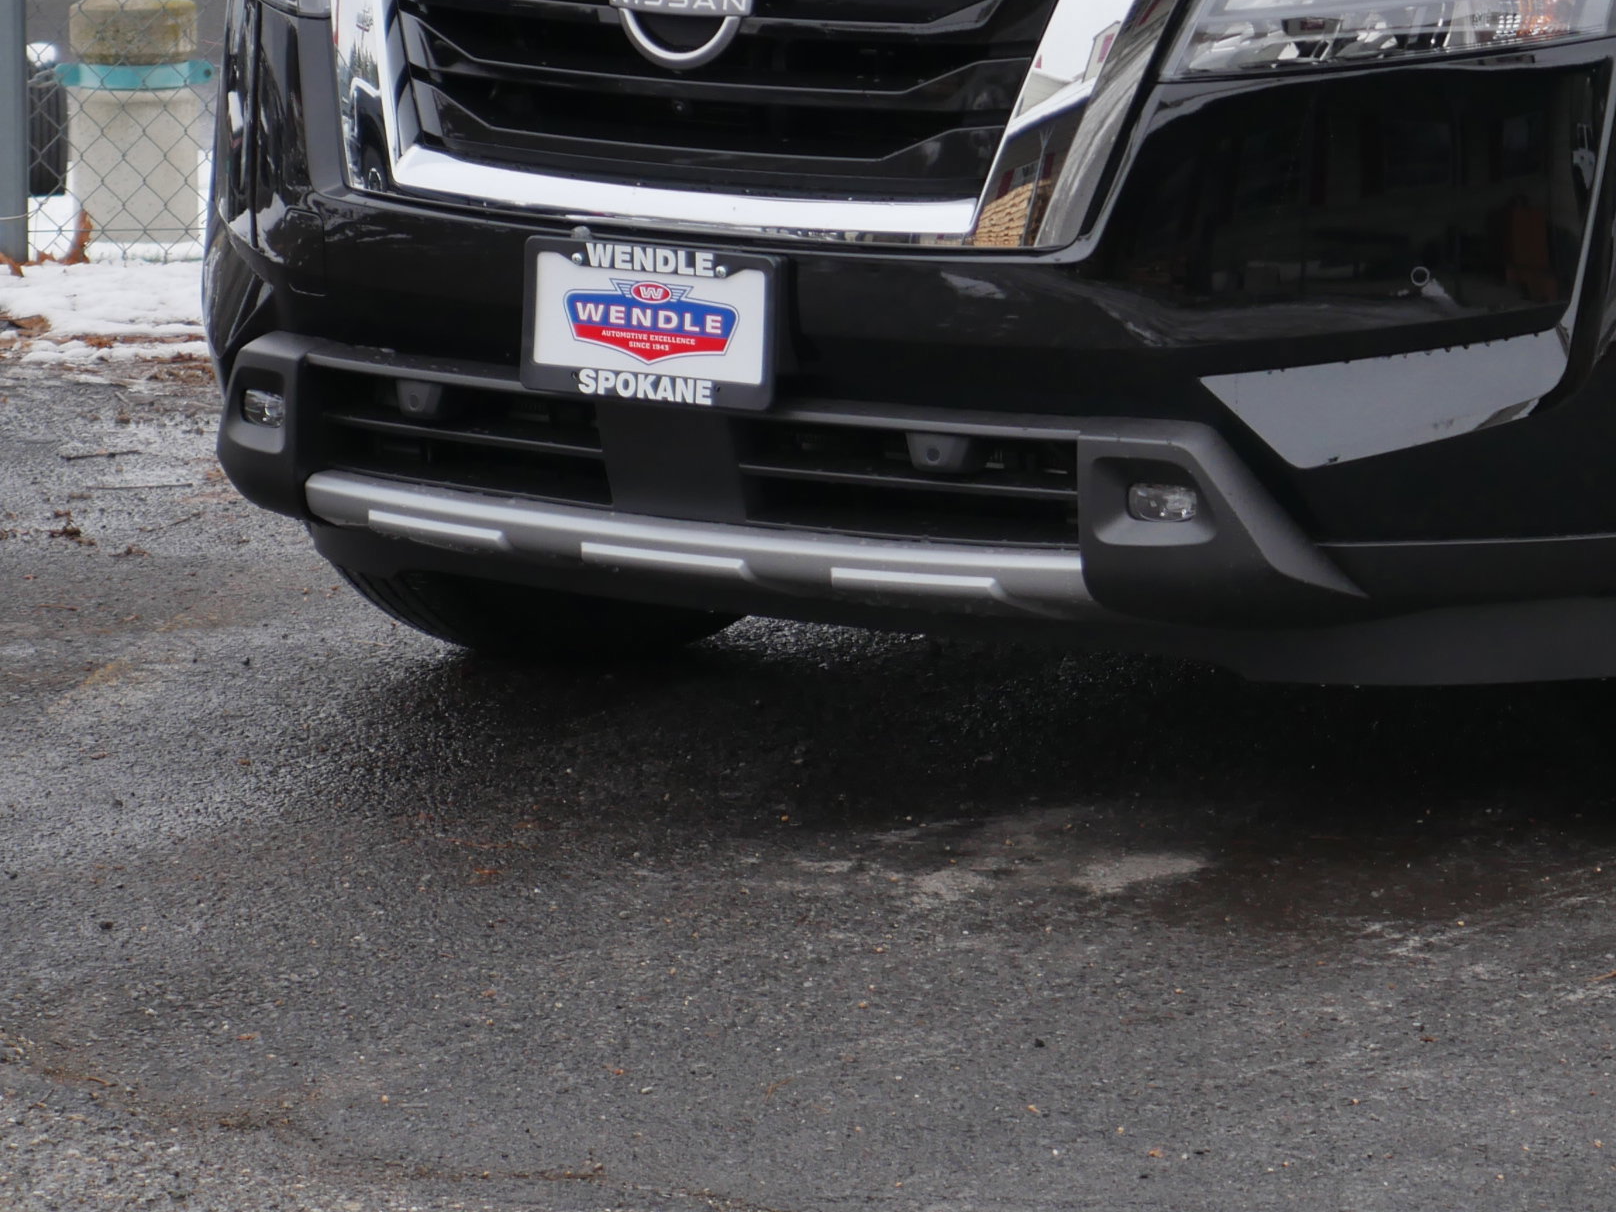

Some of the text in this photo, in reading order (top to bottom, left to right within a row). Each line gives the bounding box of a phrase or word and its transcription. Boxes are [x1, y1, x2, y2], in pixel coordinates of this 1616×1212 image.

[585, 242, 715, 277] WENDLE
[640, 285, 664, 300] W
[576, 301, 722, 334] WENDLE
[601, 329, 696, 346] AUTOMOTIVE EXCELLENCE
[628, 341, 670, 352] SINCE 1943
[578, 368, 713, 405] SPOKANE
